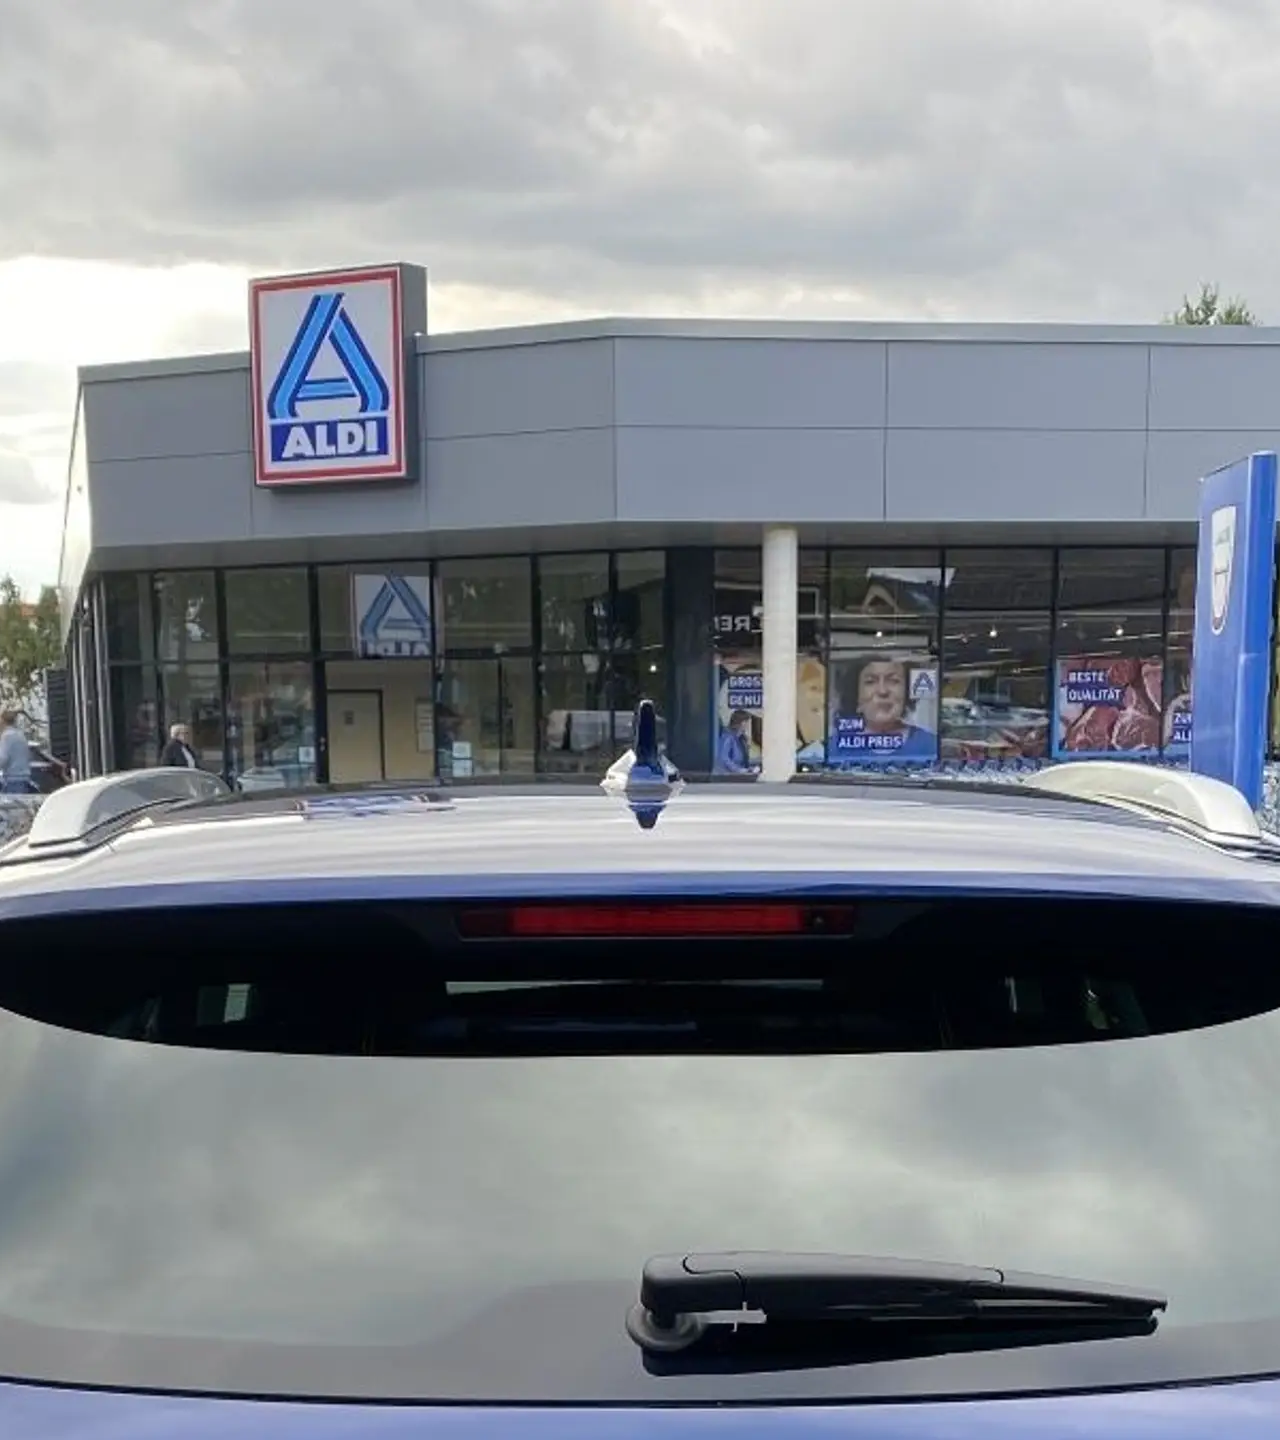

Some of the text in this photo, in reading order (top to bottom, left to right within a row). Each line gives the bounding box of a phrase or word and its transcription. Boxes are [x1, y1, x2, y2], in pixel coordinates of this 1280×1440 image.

[281, 419, 380, 459] ALDI
[1068, 671, 1105, 682] BESTE
[838, 718, 864, 730] ZUM
[838, 736, 902, 748] ALDI PREIS
